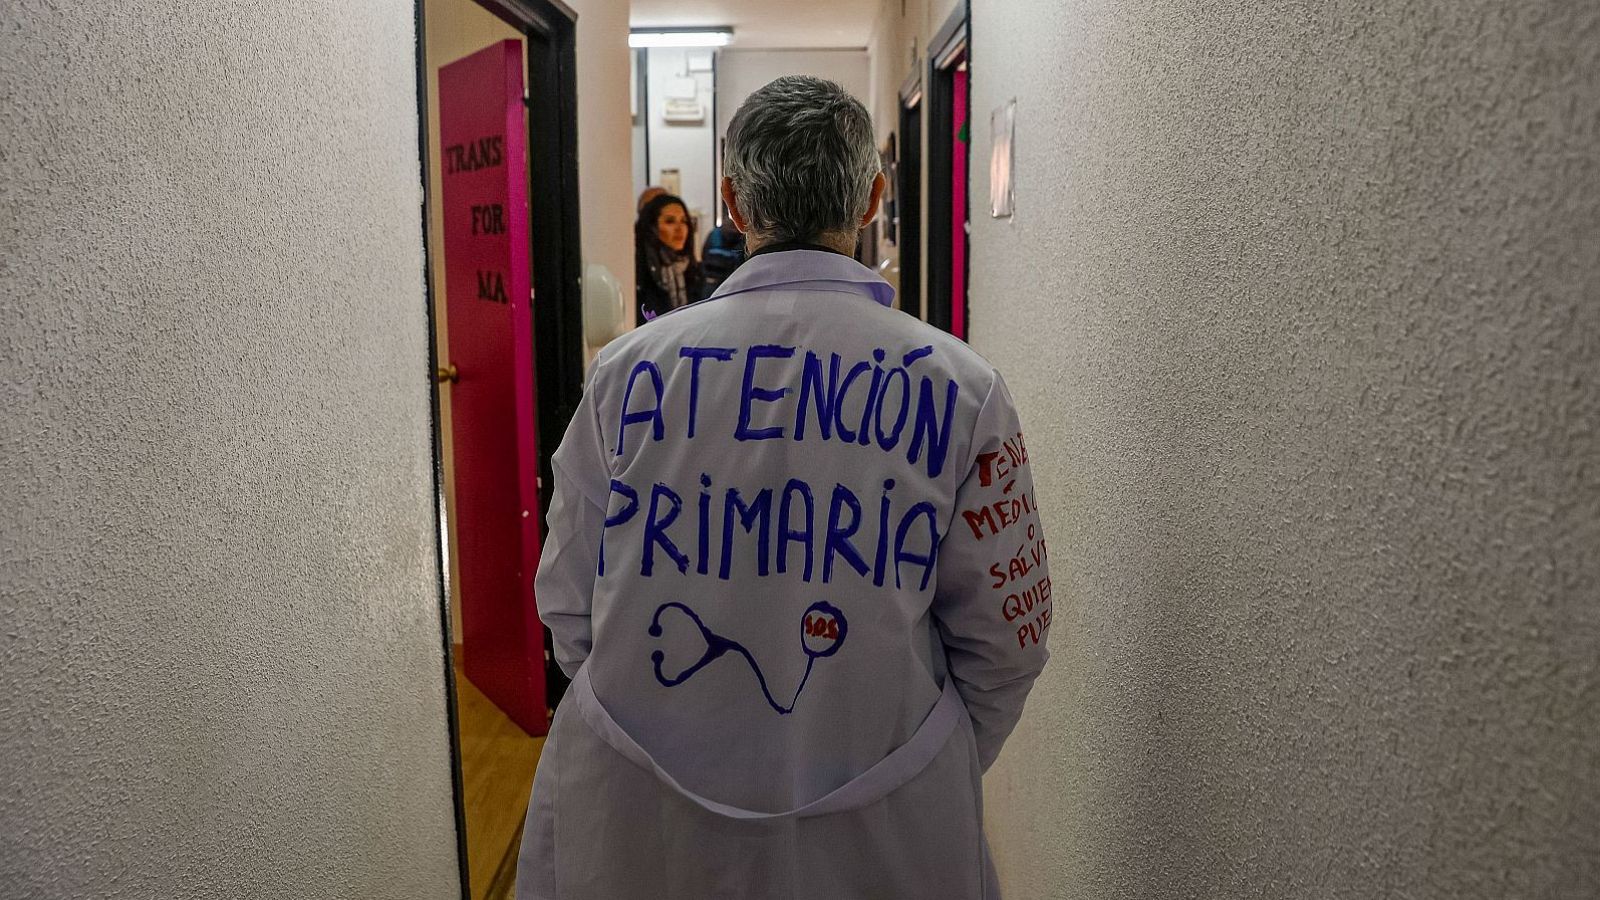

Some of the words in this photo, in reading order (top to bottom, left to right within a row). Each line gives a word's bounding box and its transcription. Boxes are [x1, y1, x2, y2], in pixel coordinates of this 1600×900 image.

[446, 136, 503, 174] TRANS
[471, 204, 506, 236] FOR
[477, 269, 510, 305] MA
[615, 345, 959, 478] ATENCIÓN
[598, 473, 941, 591] PRIMARIA
